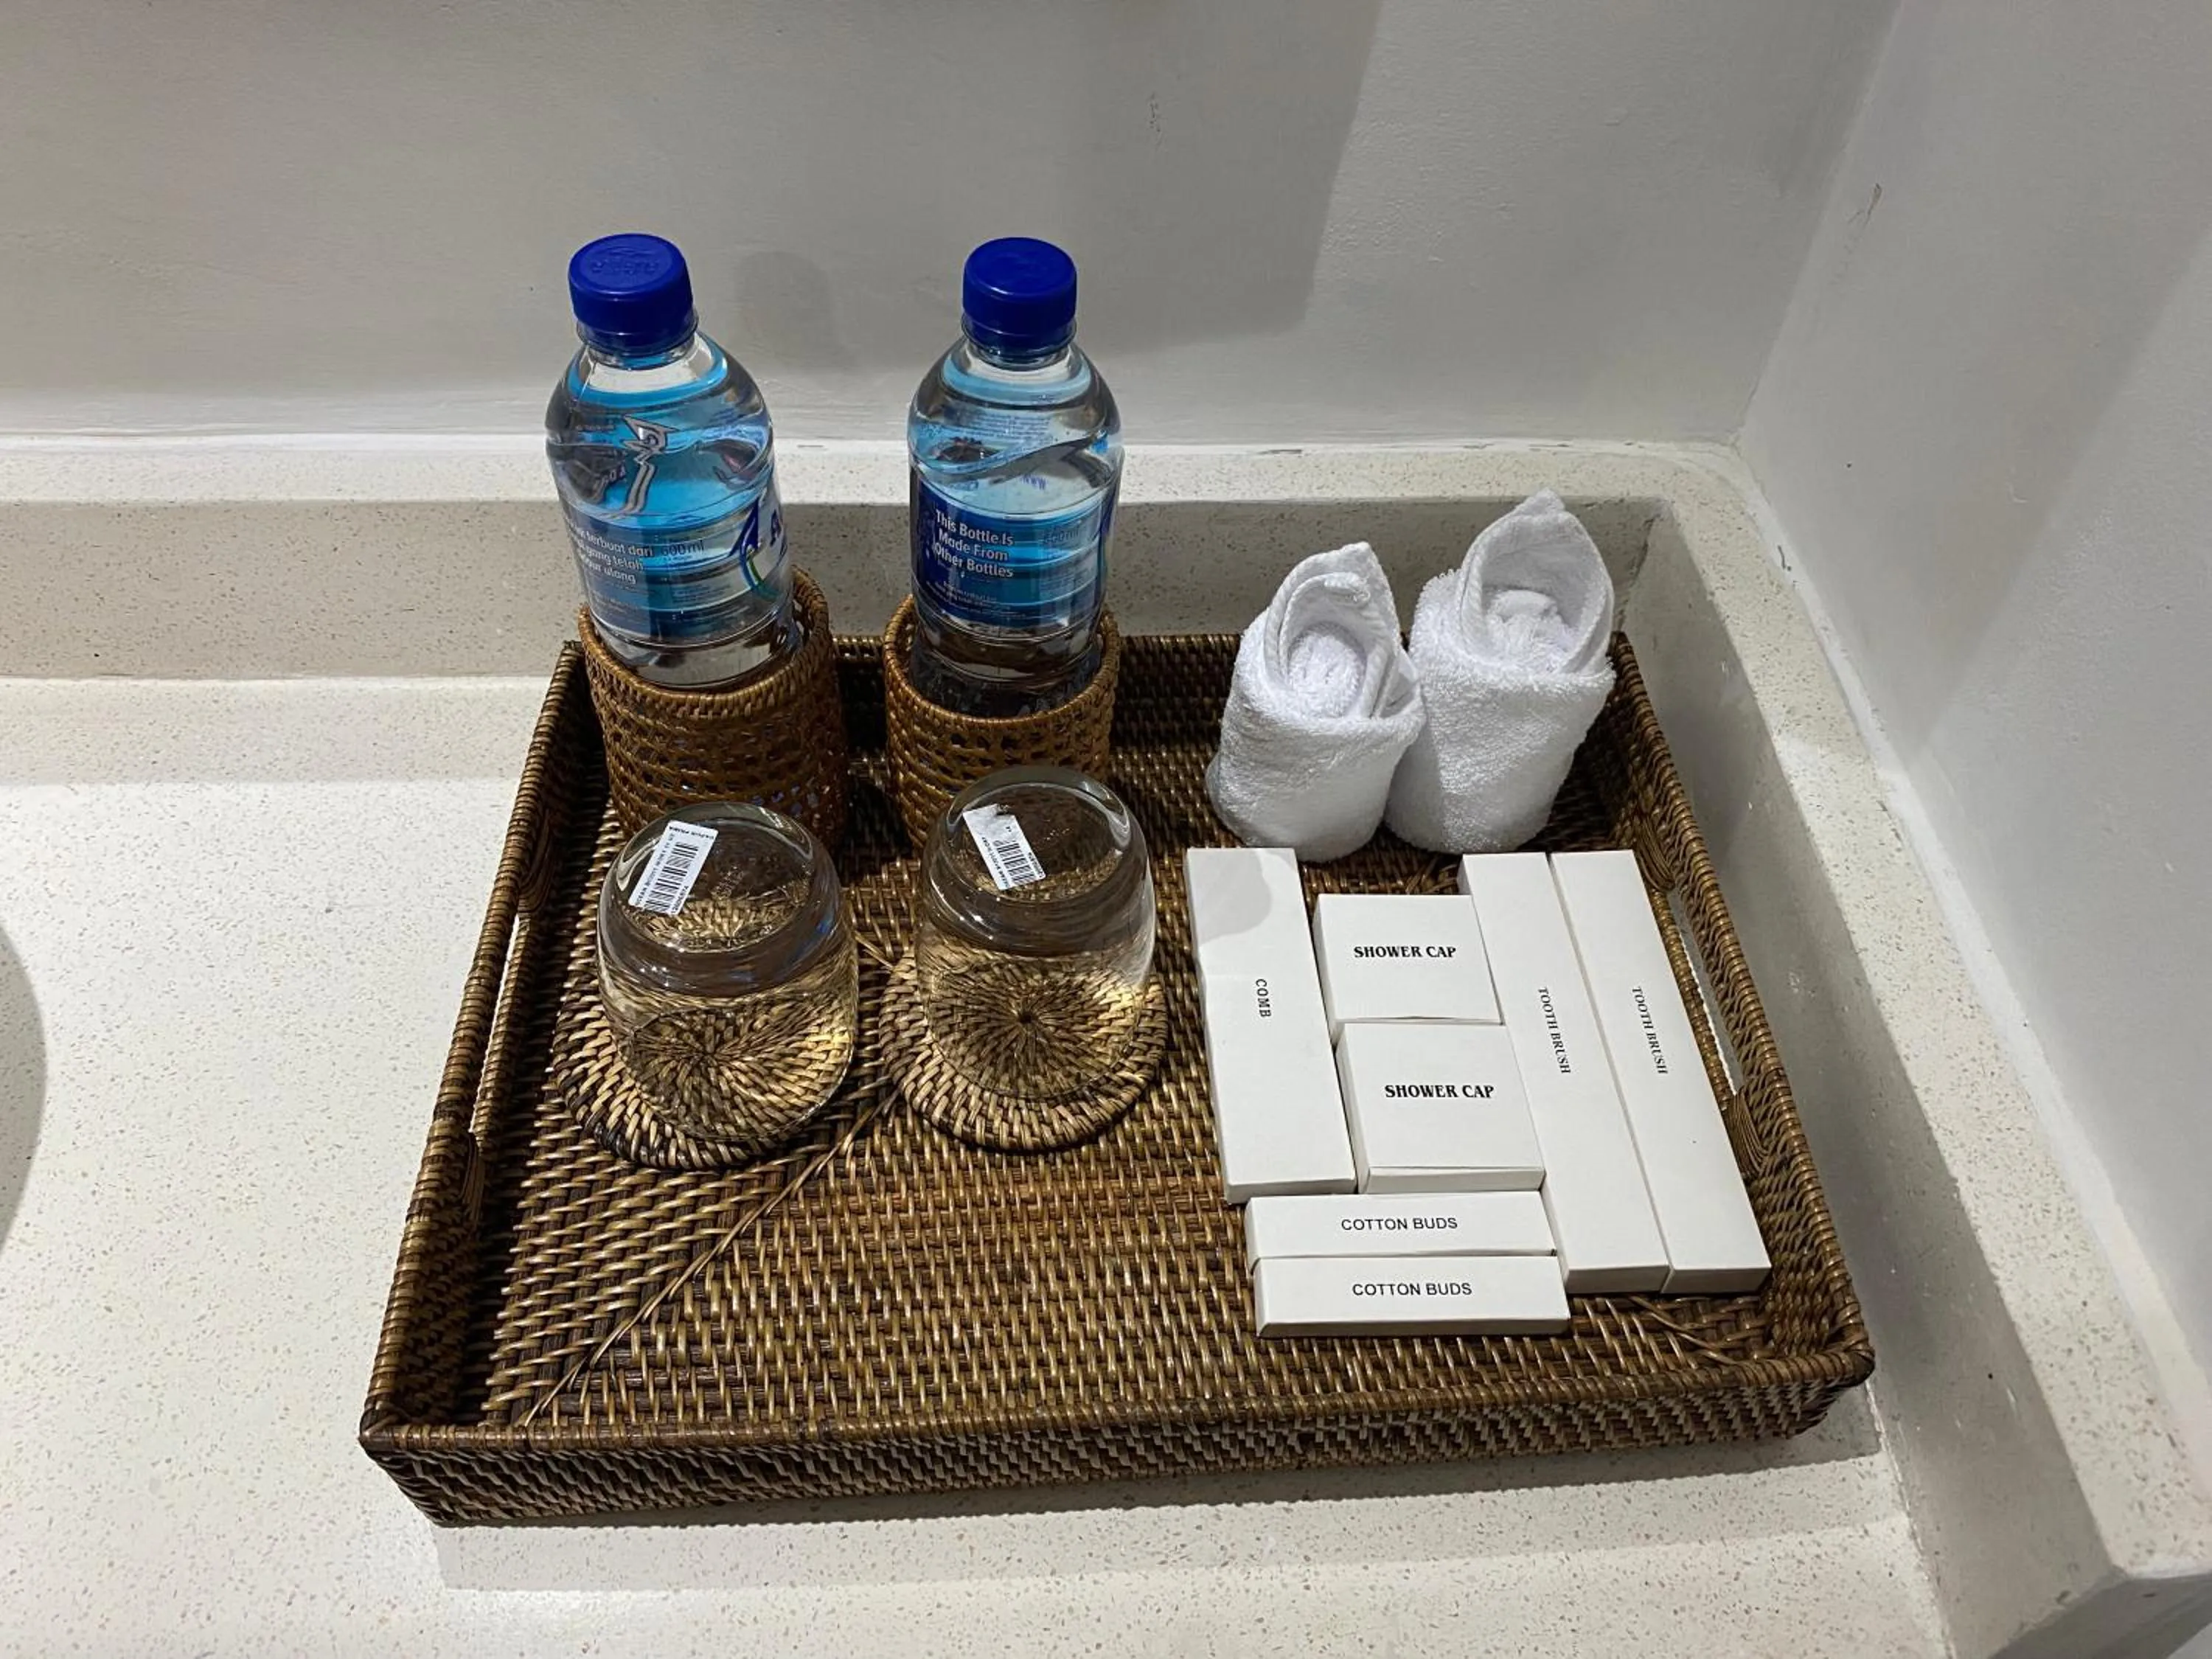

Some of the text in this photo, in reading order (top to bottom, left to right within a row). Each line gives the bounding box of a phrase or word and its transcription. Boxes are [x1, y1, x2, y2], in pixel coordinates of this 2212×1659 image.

[936, 509, 1014, 546] This Bottle Is
[628, 545, 653, 557] dari
[939, 528, 1009, 560] Made From
[934, 542, 1014, 577] Other Bottles
[604, 566, 637, 585] ulang
[1353, 946, 1457, 958] SHOWER CAP
[1255, 978, 1272, 1018] COMB
[1538, 987, 1571, 1074] TOOTH BRUSH
[1632, 987, 1668, 1074] TOOTH BRUSH
[1384, 1085, 1495, 1099] SHOWER CAP
[1340, 1217, 1458, 1231] COTTON BUDS
[1352, 1282, 1472, 1295] COTTON BUDS
